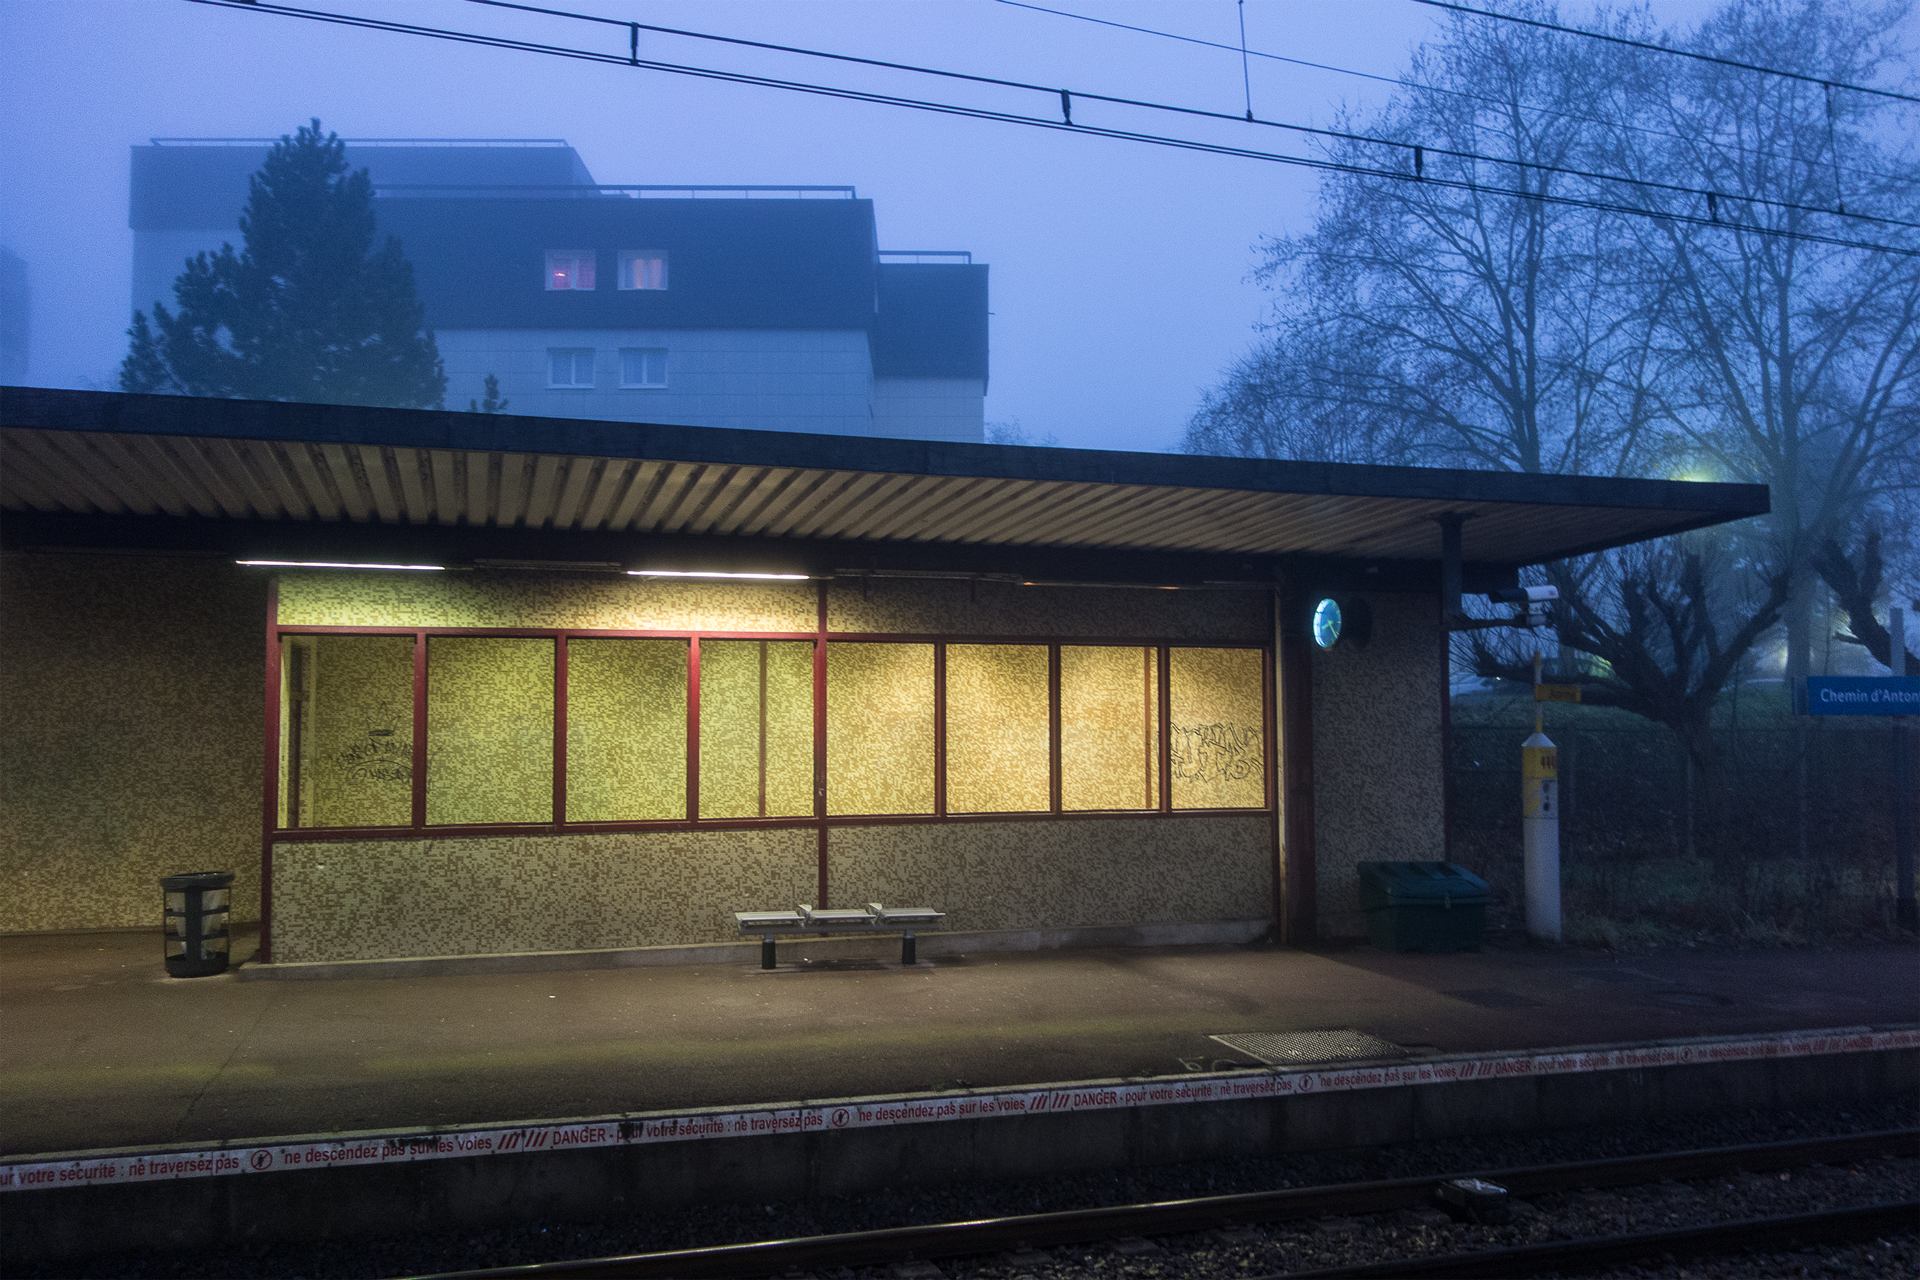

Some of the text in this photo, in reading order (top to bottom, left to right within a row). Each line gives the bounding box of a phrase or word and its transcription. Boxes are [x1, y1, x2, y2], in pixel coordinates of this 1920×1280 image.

[1820, 688, 1868, 702] Chemin
[1496, 1059, 1532, 1074] DANGER
[1074, 1091, 1117, 1107] DANGER
[1125, 1091, 1147, 1104] pour
[1150, 1087, 1173, 1100] votre
[1219, 1084, 1232, 1095] ne
[1233, 1079, 1274, 1095] traversez
[1275, 1079, 1293, 1094] pas
[1320, 1075, 1332, 1087] ne
[1334, 1072, 1382, 1086] descendez
[1384, 1071, 1401, 1084] pas
[553, 1127, 606, 1146] DANGER
[647, 1123, 676, 1137] votre
[735, 1119, 749, 1131] ne
[751, 1115, 800, 1130] traversez
[804, 1115, 823, 1129] pas
[858, 1110, 872, 1122] ne
[876, 1105, 935, 1121] descendez
[937, 1103, 956, 1118] pas
[959, 1102, 977, 1115] sur
[979, 1099, 994, 1113] les
[998, 1097, 1025, 1111] voies
[19, 1168, 55, 1184] votre
[128, 1163, 145, 1176] ne
[149, 1158, 212, 1175] traversez
[215, 1157, 240, 1173] pas
[284, 1151, 300, 1165] ne
[305, 1144, 378, 1163] descendez
[382, 1143, 405, 1161] pas
[458, 1136, 492, 1151] voies
